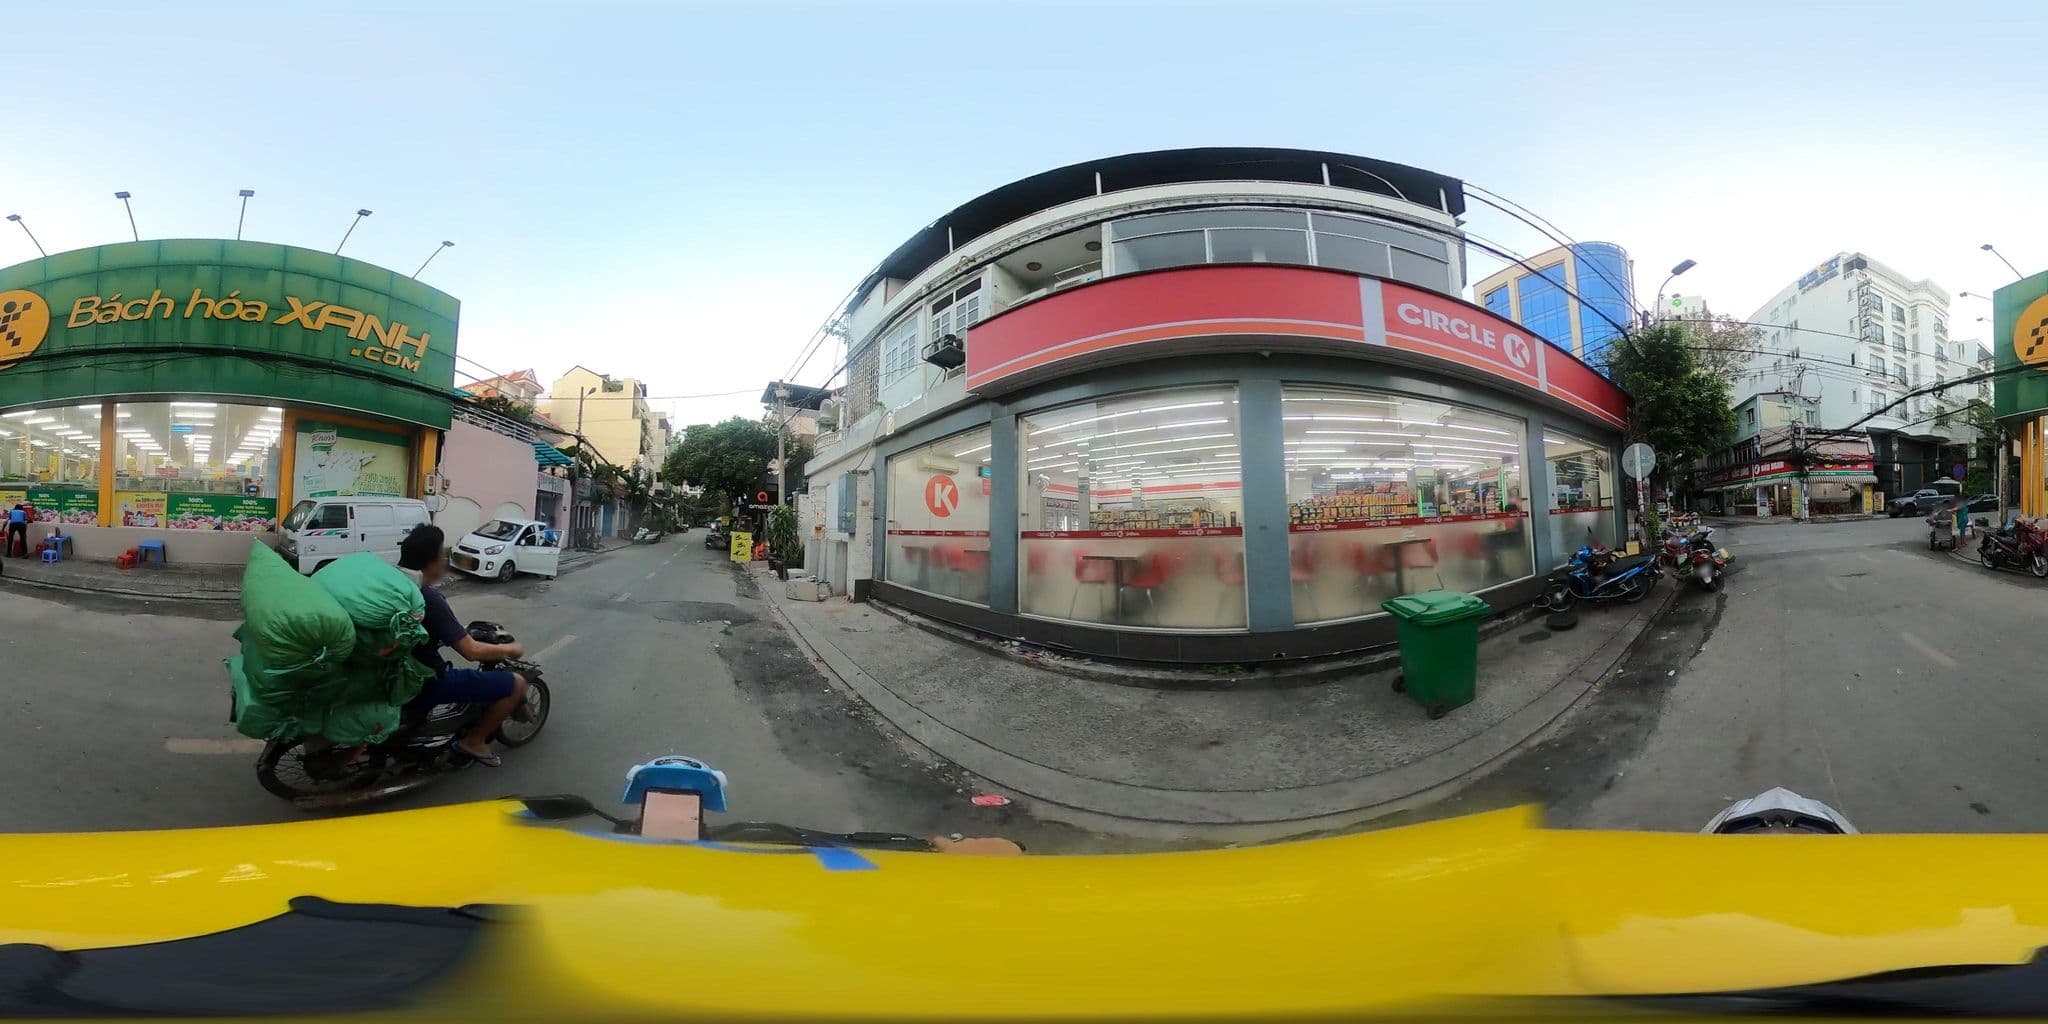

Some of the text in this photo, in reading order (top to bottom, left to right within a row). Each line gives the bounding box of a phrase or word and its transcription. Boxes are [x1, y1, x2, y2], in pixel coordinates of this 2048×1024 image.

[67, 288, 432, 358] Bách hóa XANH
[1397, 302, 1529, 367] CIRCLE K
[351, 346, 422, 374] .COM
[931, 481, 959, 516] K
